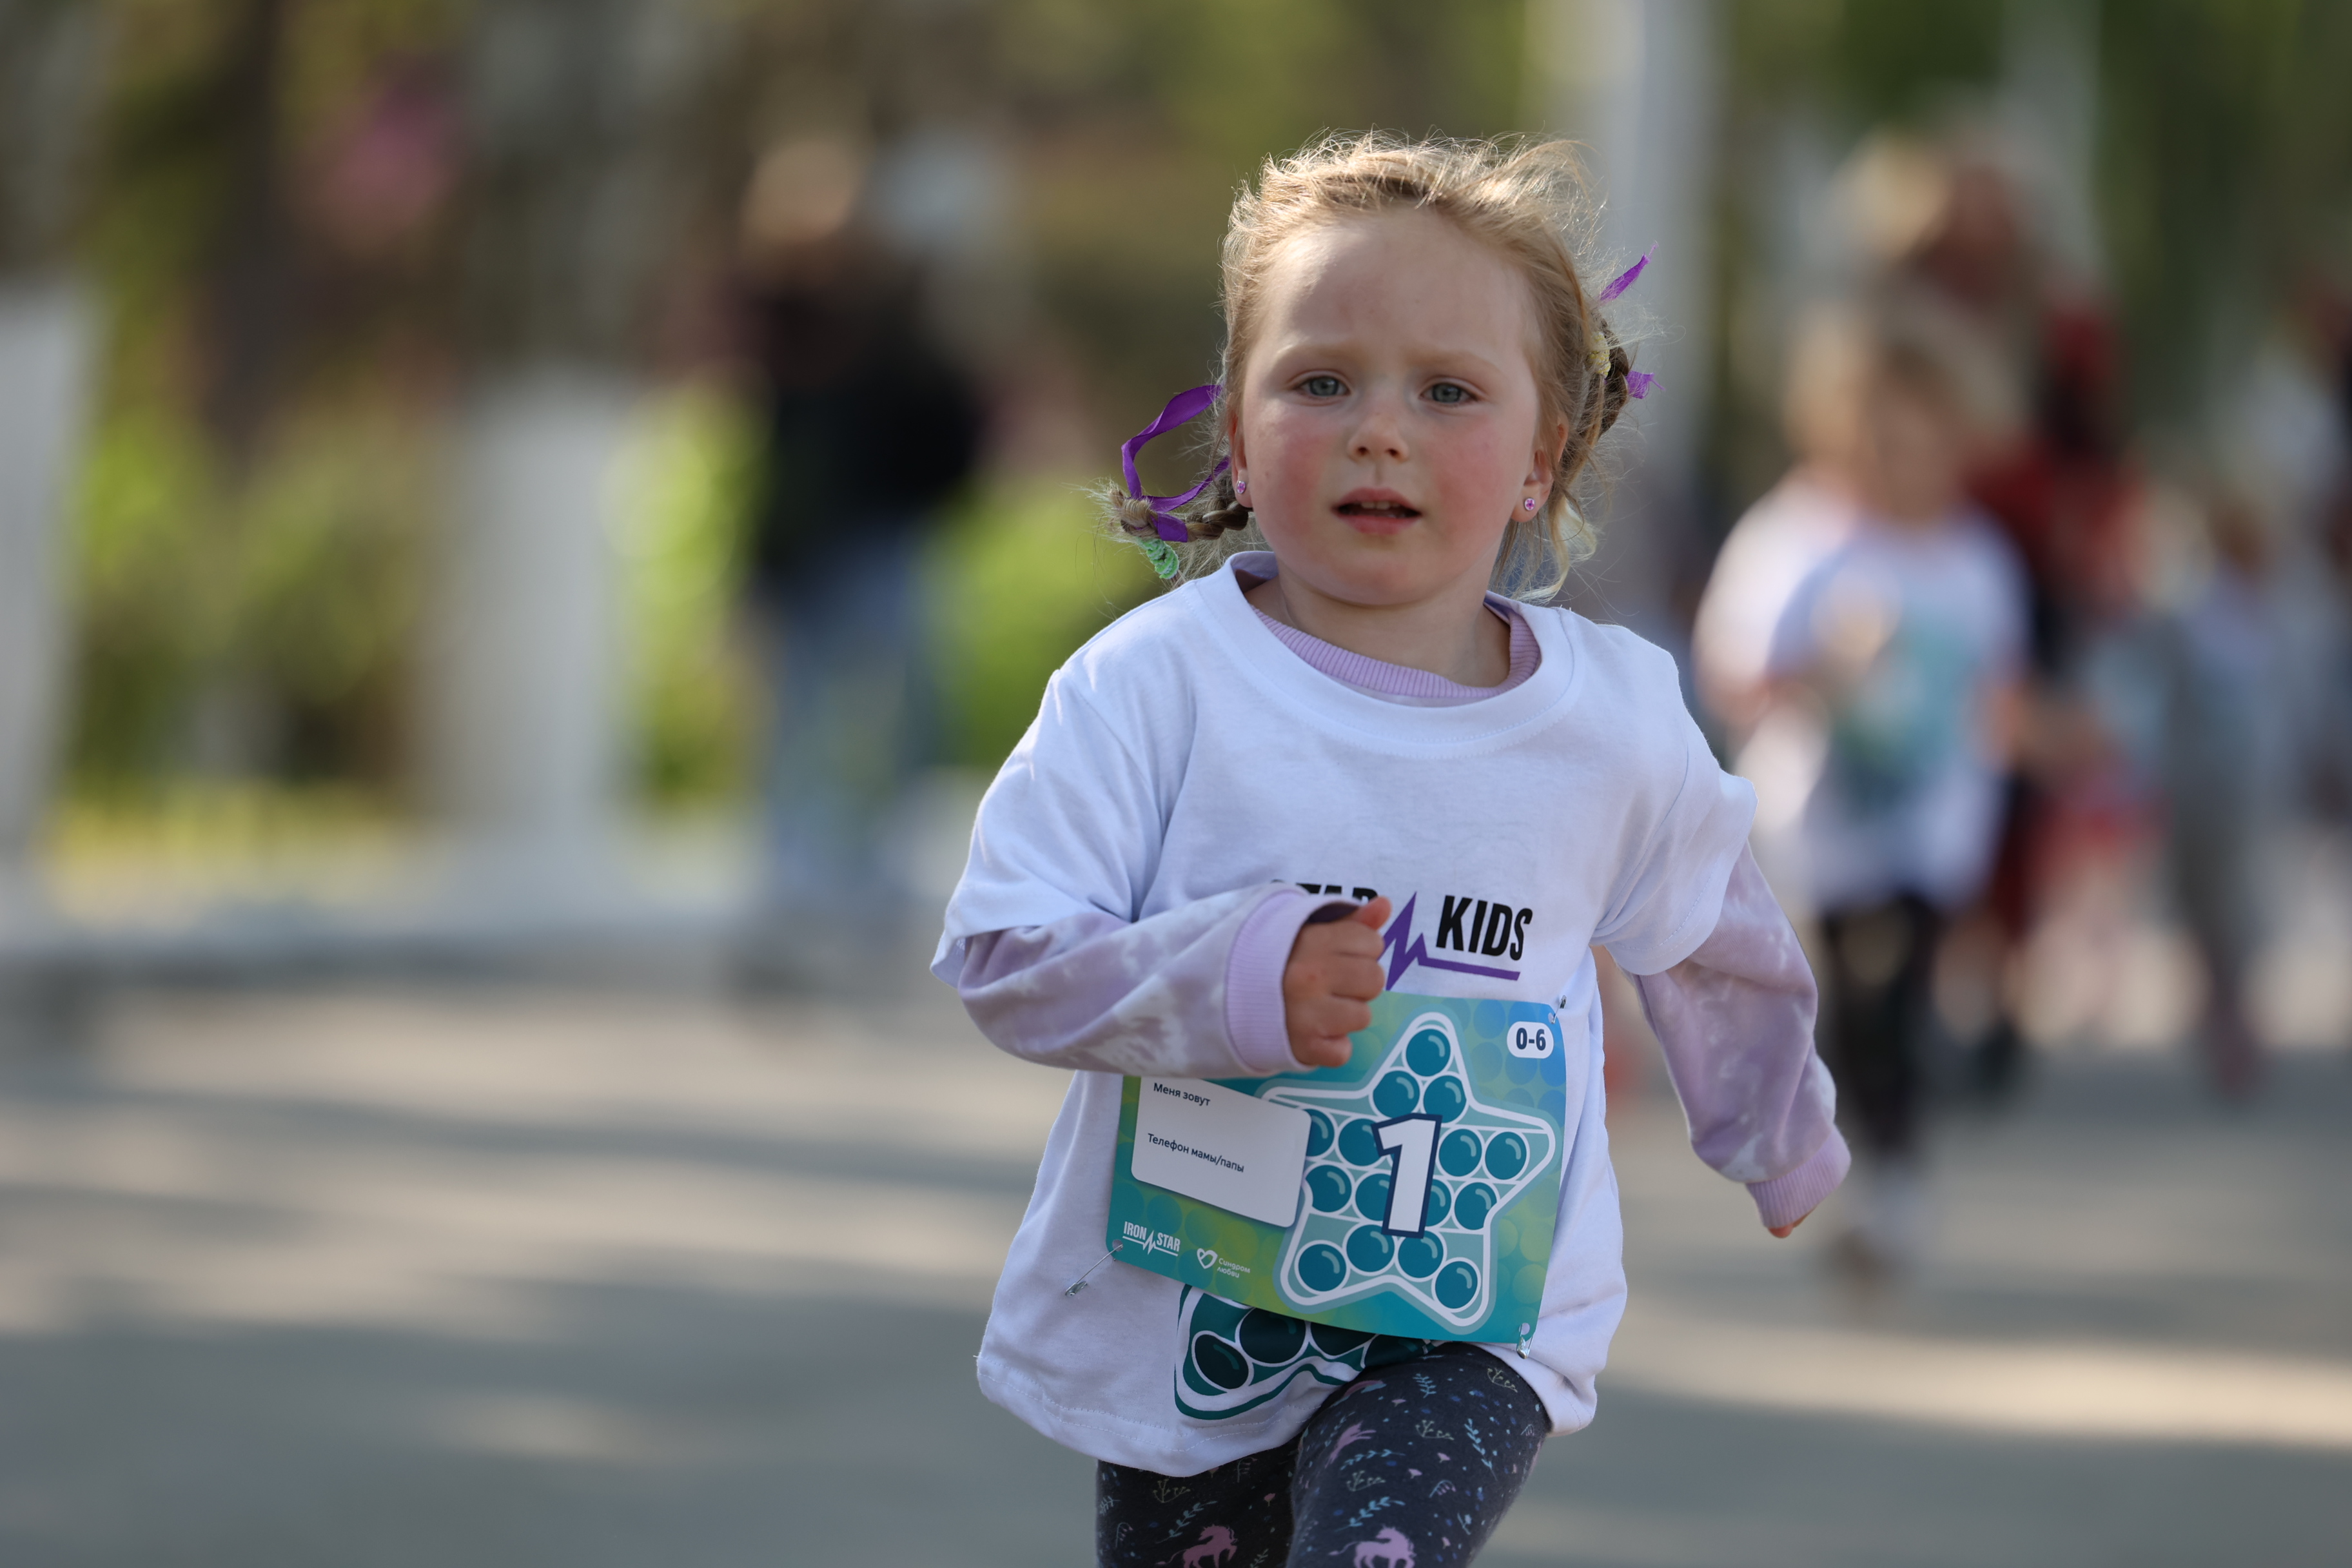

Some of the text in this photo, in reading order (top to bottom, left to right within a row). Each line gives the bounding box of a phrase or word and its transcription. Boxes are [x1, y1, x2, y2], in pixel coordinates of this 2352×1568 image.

[1436, 894, 1533, 961] KIDS
[1515, 1028, 1546, 1051] 0-6
[1153, 1083, 1211, 1106] Меня зовут
[1148, 1133, 1244, 1173] Телефон мамы/папы
[1371, 1112, 1443, 1239] 1
[1123, 1221, 1181, 1252] IRON STAR
[1219, 1258, 1251, 1273] Синдром
